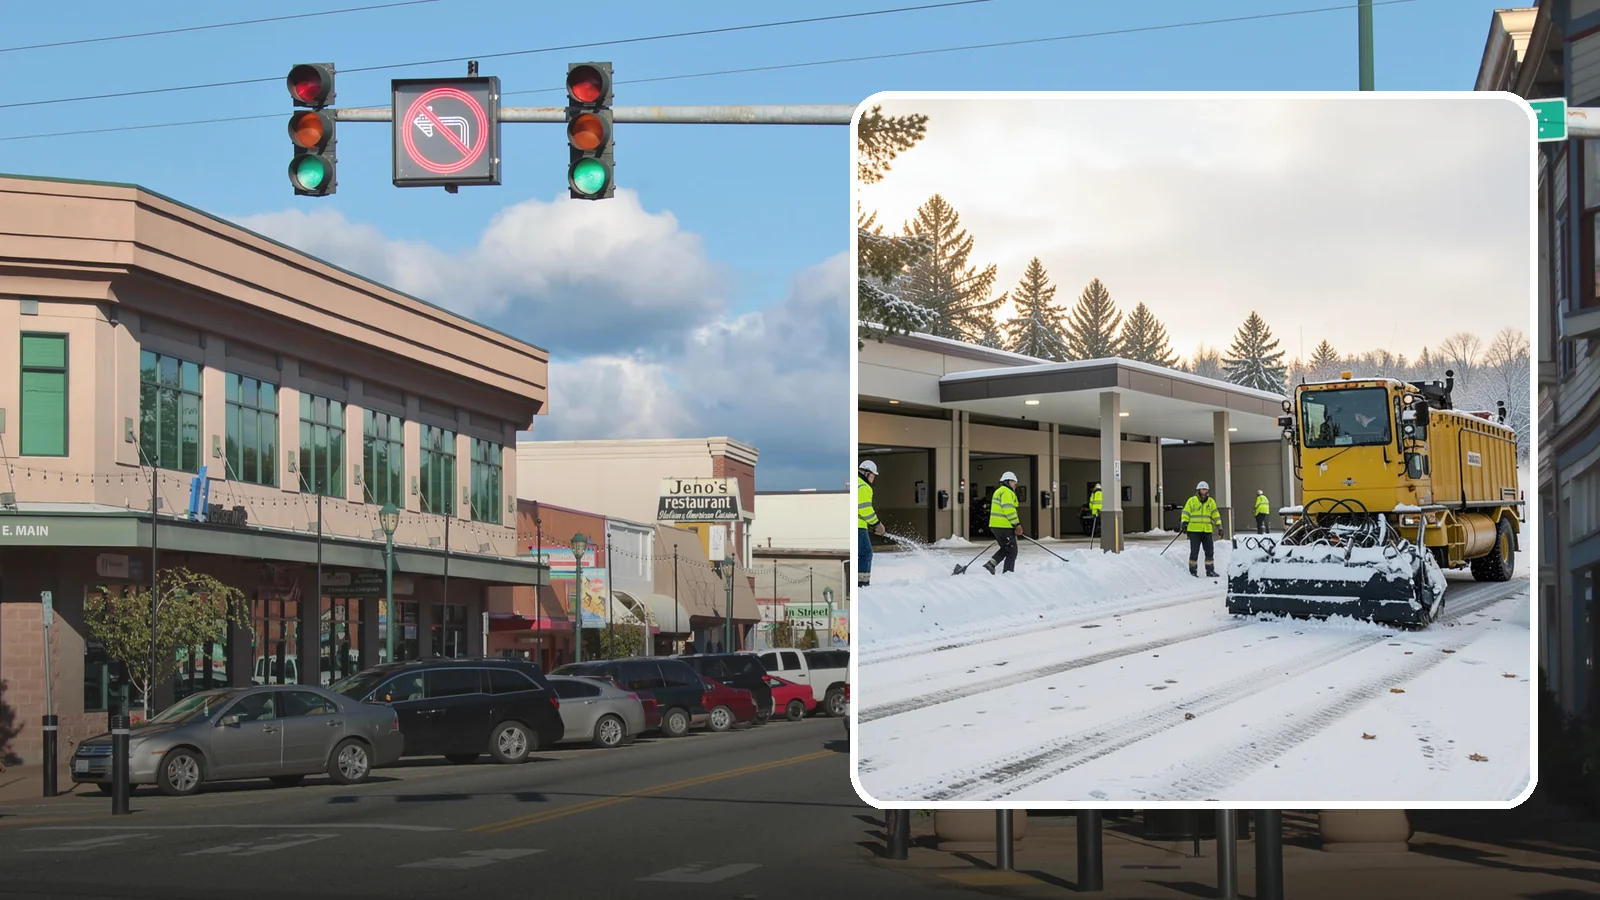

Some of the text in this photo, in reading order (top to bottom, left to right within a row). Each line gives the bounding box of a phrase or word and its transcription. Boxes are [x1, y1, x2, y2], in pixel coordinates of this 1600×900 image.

[670, 480, 727, 494] Jeno's
[665, 496, 730, 508] restaurant
[686, 510, 714, 519] American
[715, 510, 737, 519] Cuisine
[2, 525, 49, 536] E. MAIN
[797, 607, 828, 616] Street
